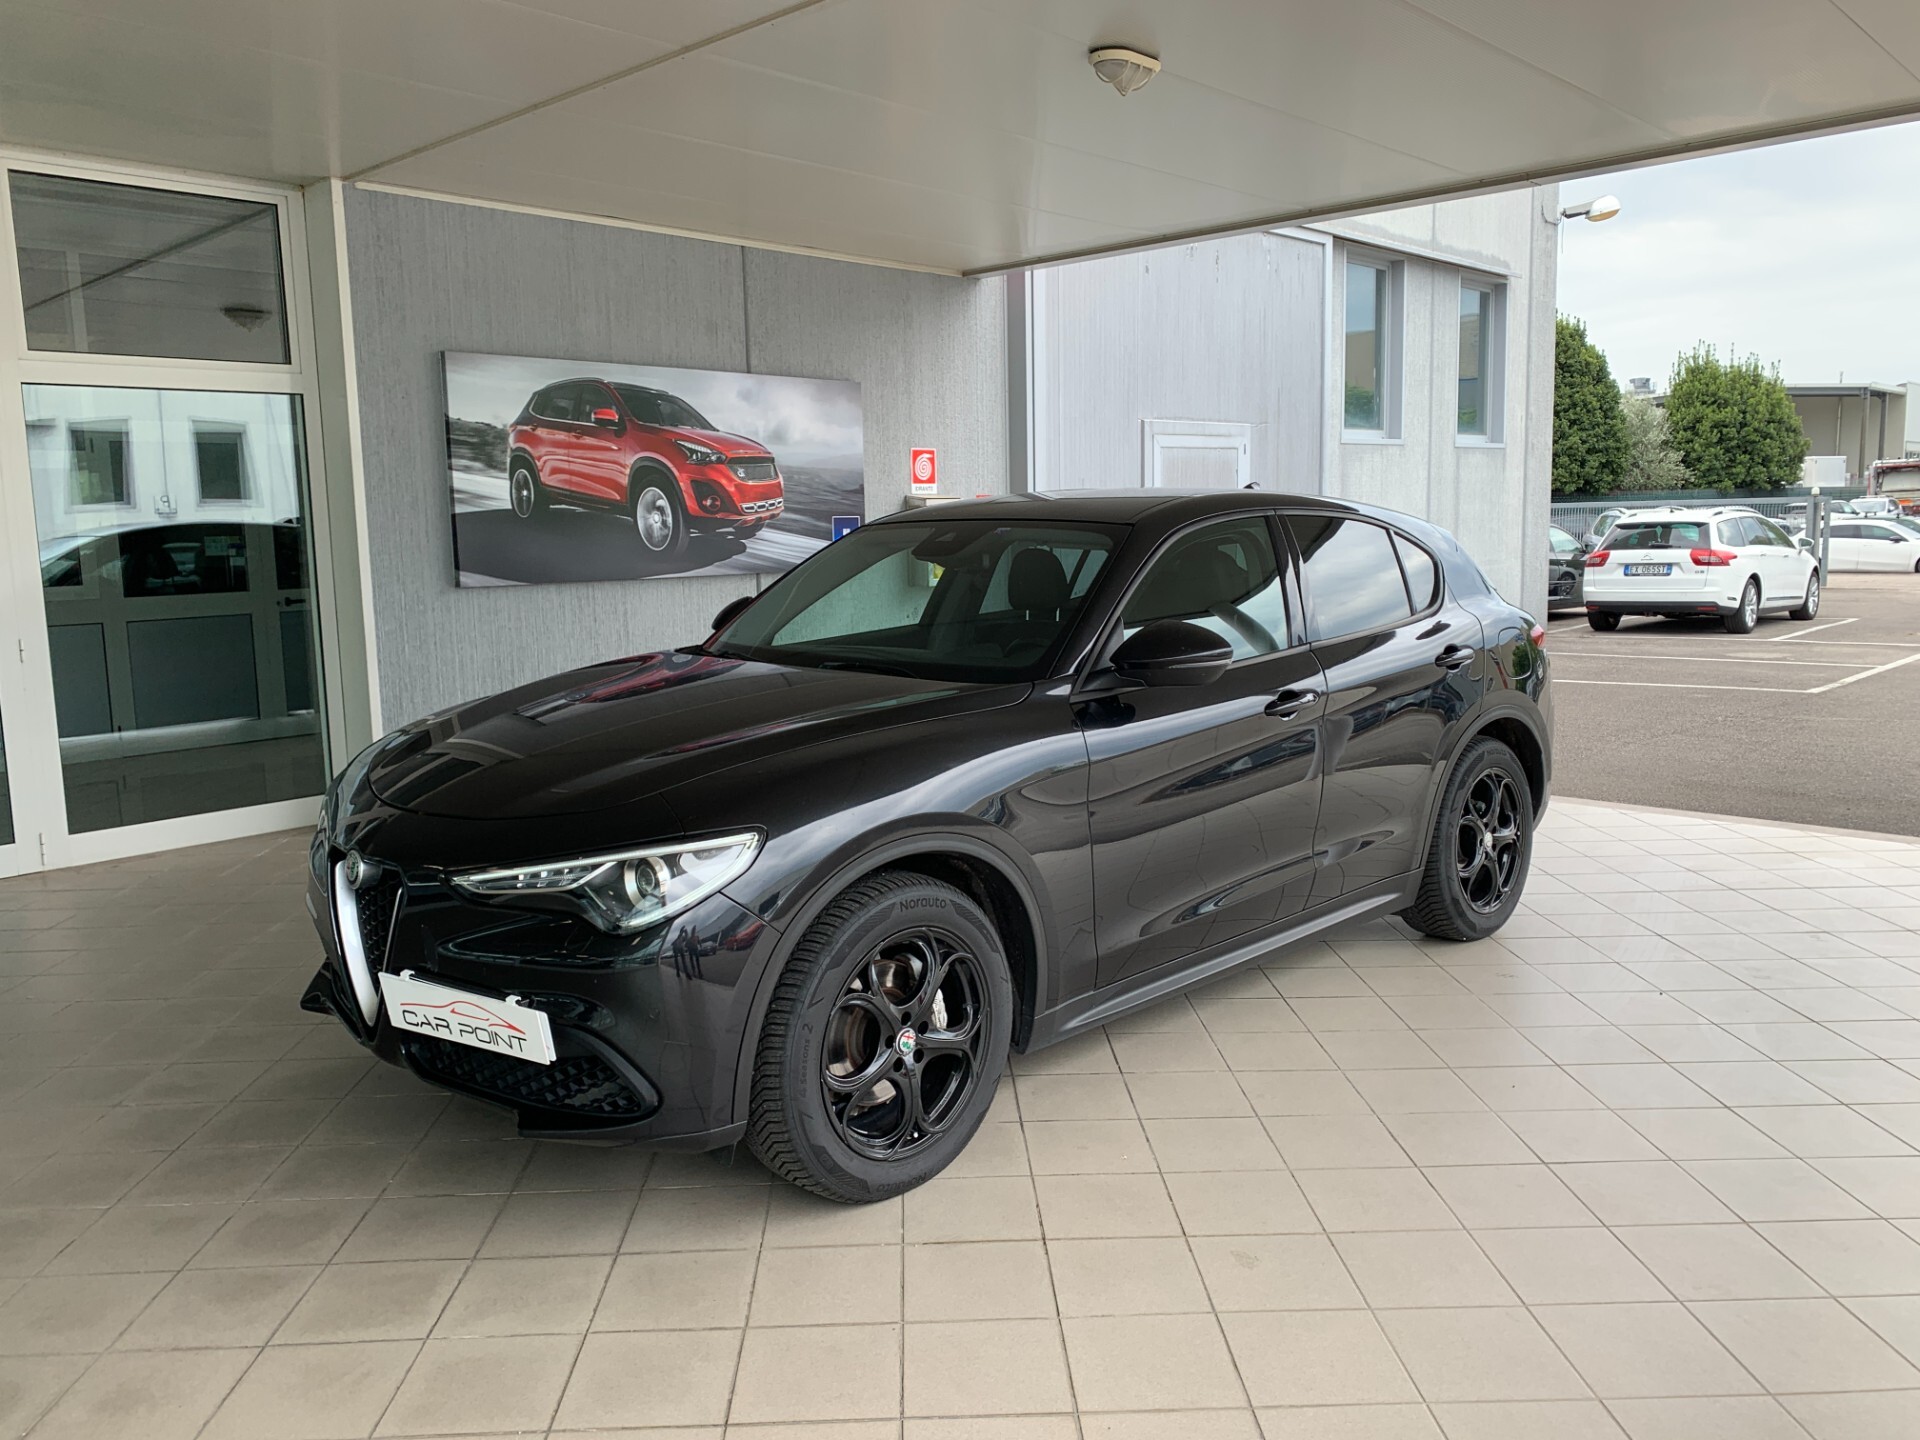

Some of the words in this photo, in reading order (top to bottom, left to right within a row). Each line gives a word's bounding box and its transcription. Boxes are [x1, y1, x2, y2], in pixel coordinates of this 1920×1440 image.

[899, 896, 947, 912] Norauto
[402, 1009, 453, 1035] CAR
[457, 1021, 527, 1052] POINT
